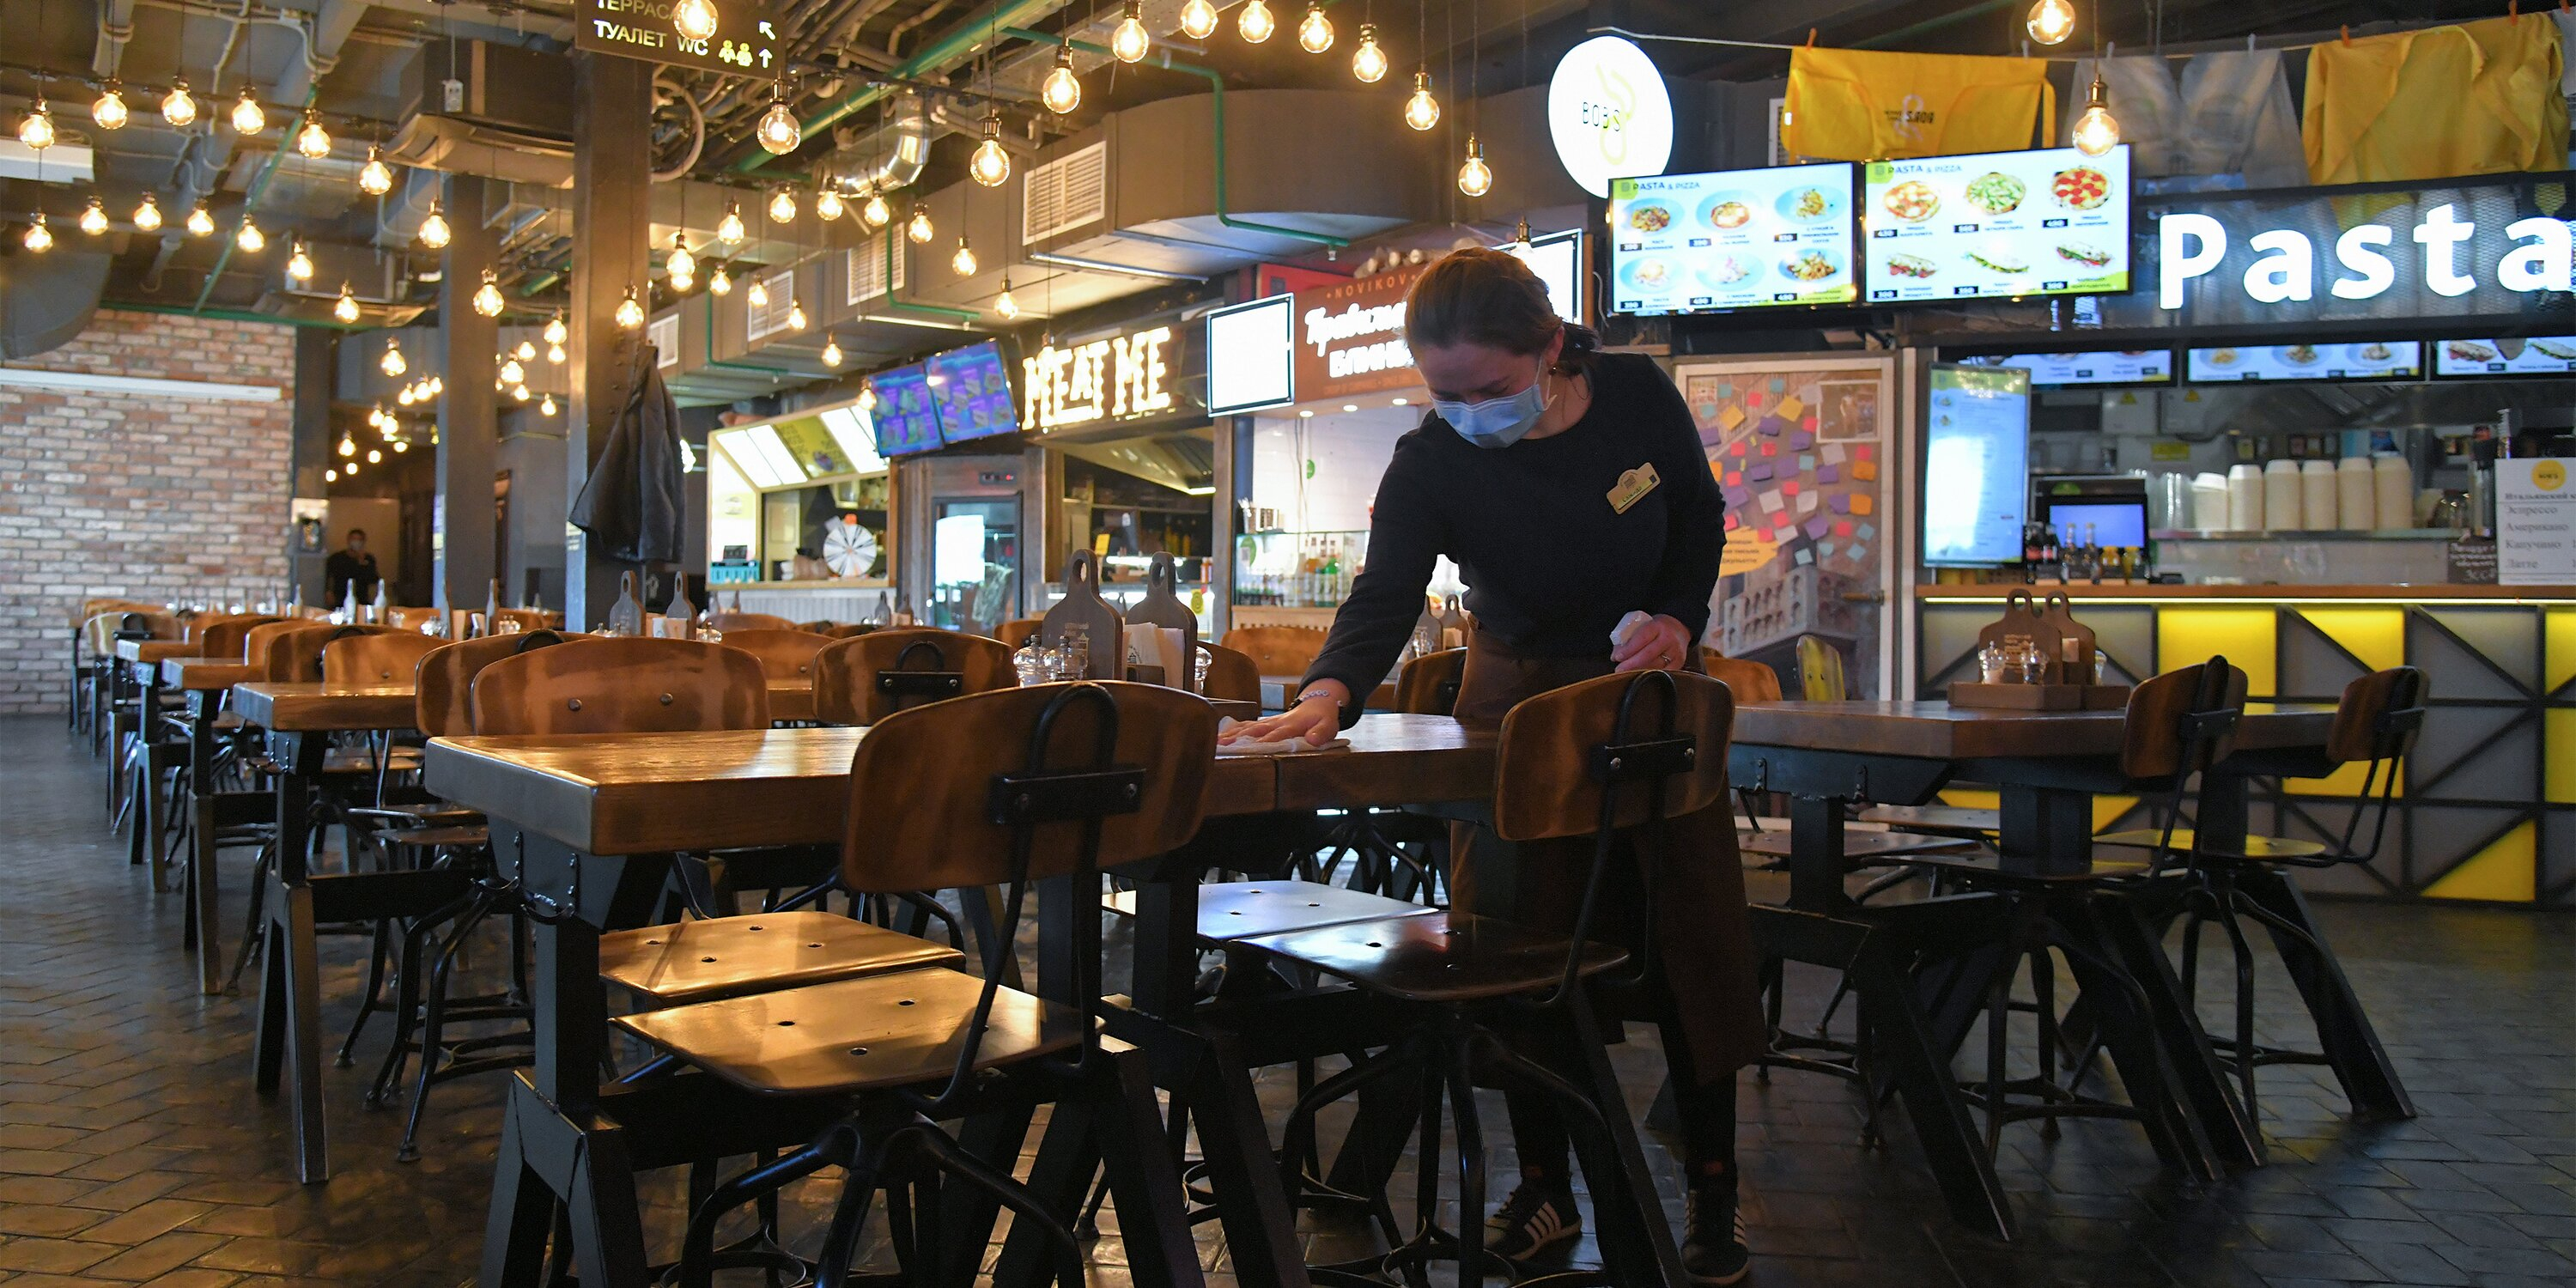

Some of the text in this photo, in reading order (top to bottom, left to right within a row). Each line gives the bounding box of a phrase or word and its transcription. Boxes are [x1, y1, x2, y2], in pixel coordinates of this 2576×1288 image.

[598, 0, 675, 20] ЕРРАС
[593, 19, 708, 56] ТУАЛЕТ WC
[1887, 165, 1923, 174] PASTA
[1632, 181, 1665, 191] PASTA
[2160, 204, 2576, 309] Pasta
[1335, 274, 1406, 299] NOVIKOV
[1022, 326, 1171, 430] MEAT ME
[2505, 522, 2569, 533] Американо
[2505, 538, 2562, 551] Капучино
